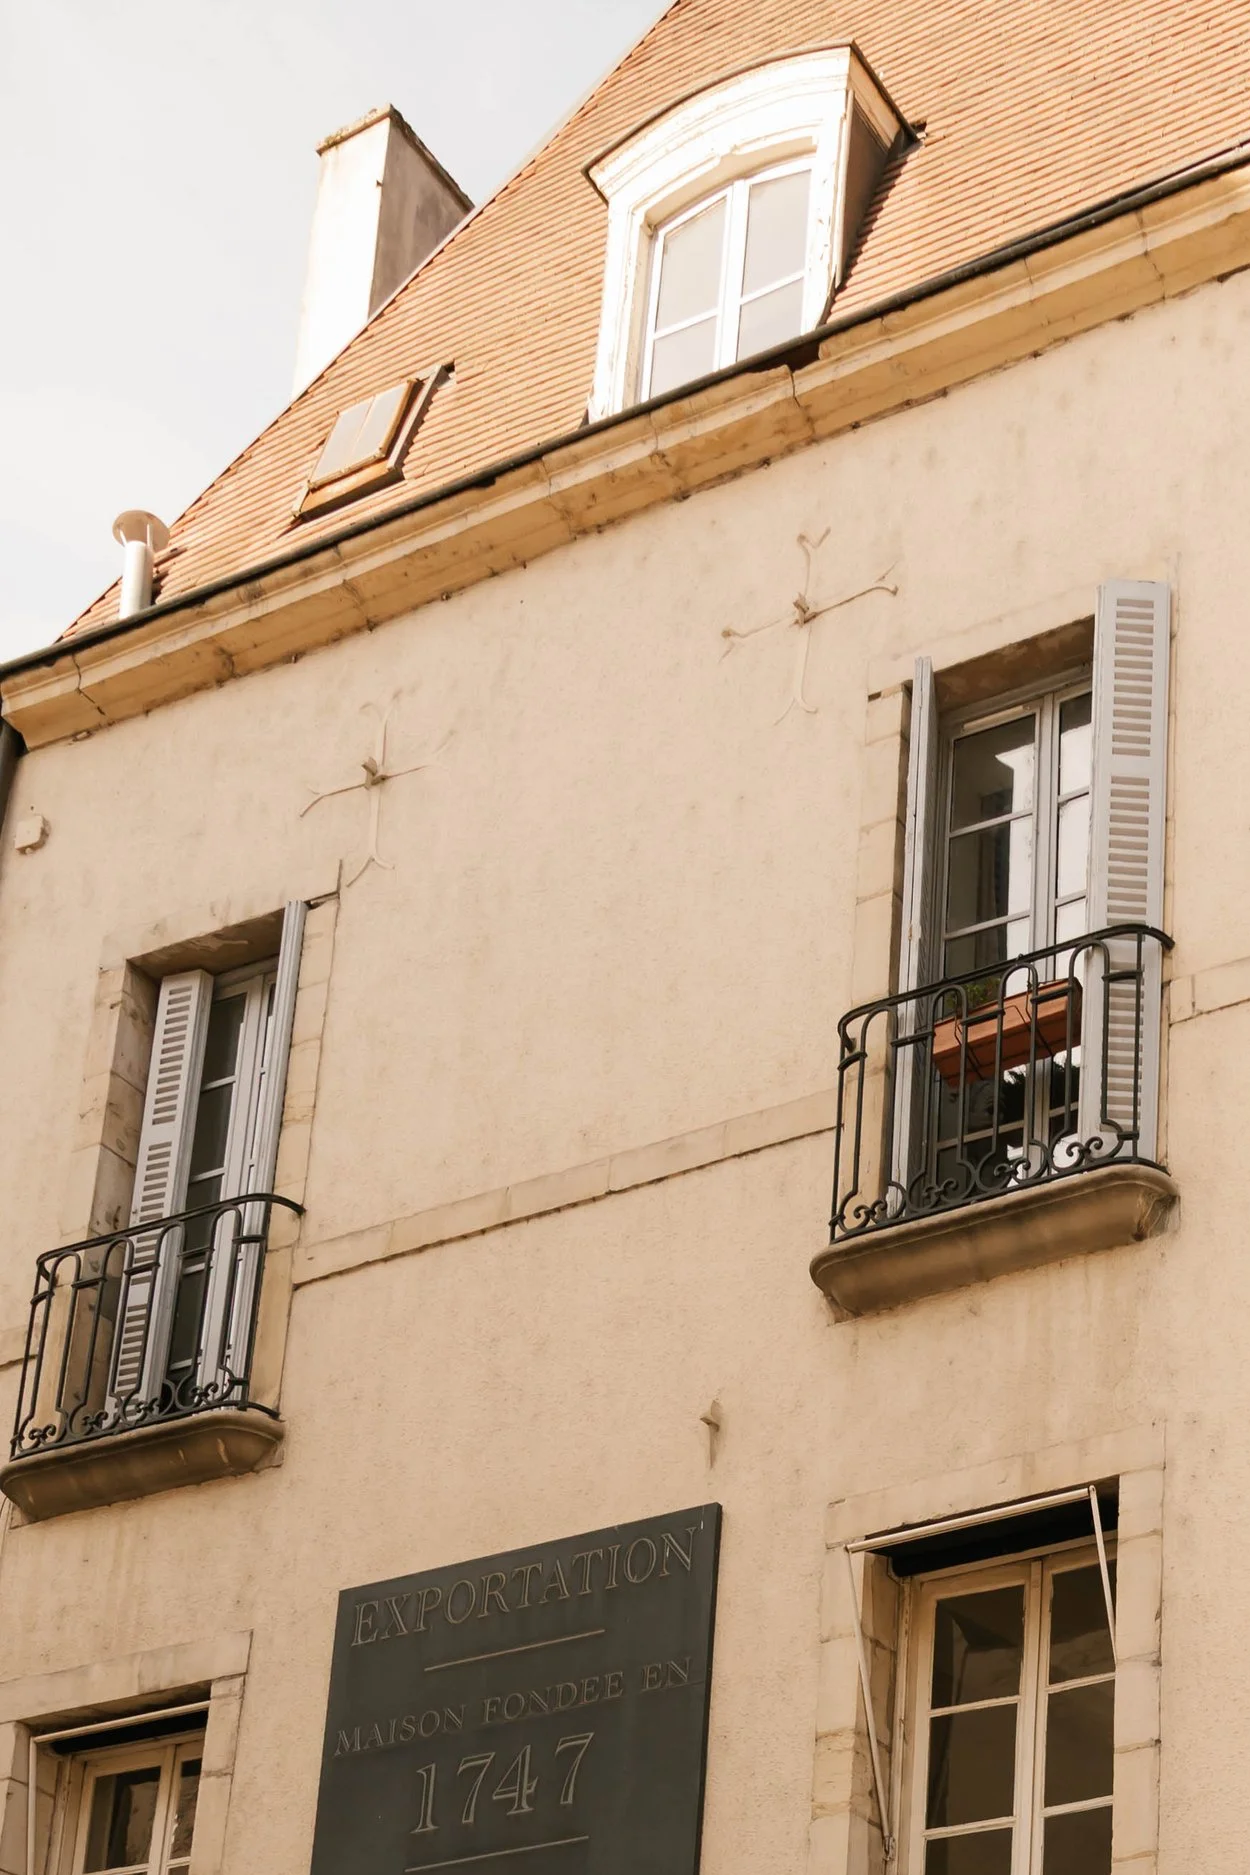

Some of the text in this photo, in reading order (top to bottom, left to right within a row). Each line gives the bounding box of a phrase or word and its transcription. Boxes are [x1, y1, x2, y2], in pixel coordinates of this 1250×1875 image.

[351, 1527, 698, 1648] EXPORTATION
[333, 1657, 692, 1757] MAISON FONDEE EN
[410, 1732, 594, 1835] 1747
